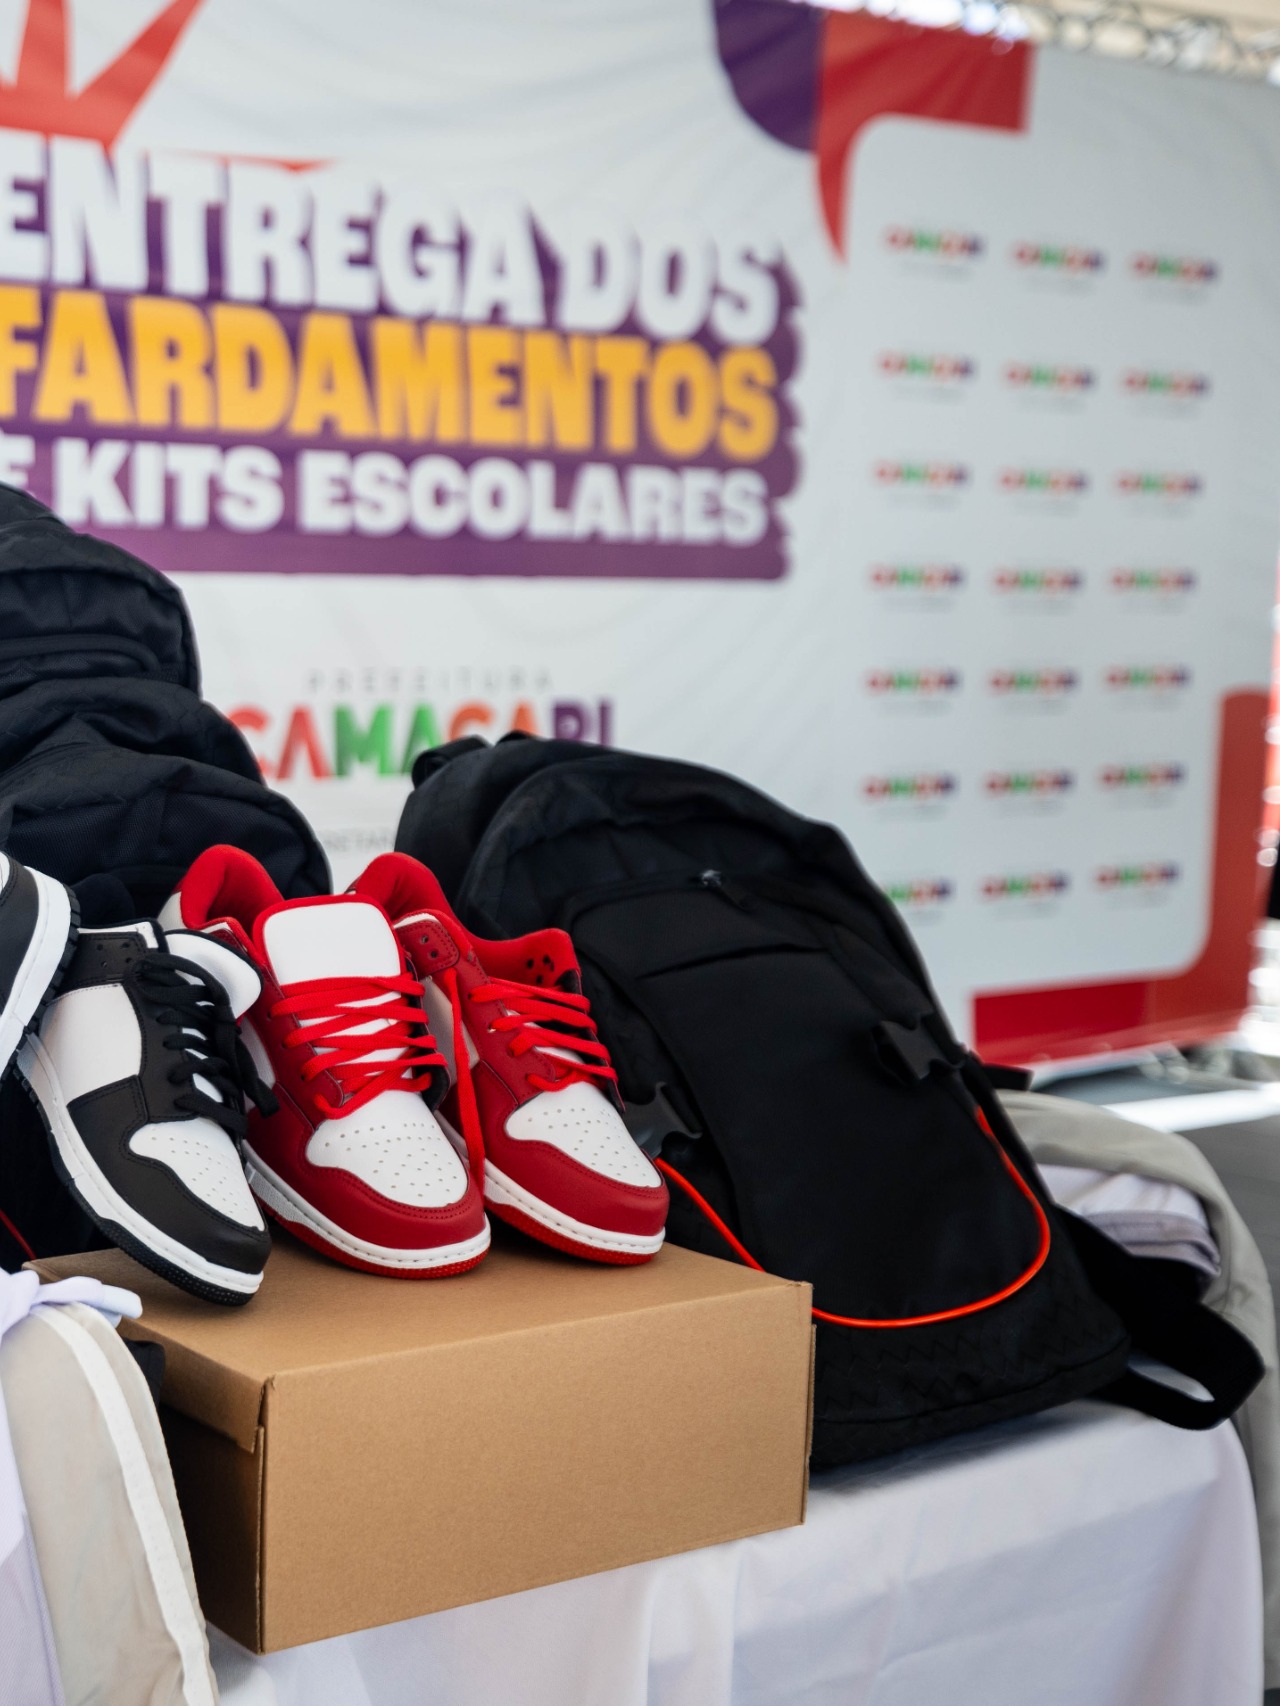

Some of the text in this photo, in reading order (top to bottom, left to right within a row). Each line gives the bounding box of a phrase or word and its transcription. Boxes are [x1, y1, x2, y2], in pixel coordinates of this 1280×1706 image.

[560, 202, 780, 346] DOS
[53, 437, 286, 533] KITS
[297, 447, 772, 548] ESCOLARES
